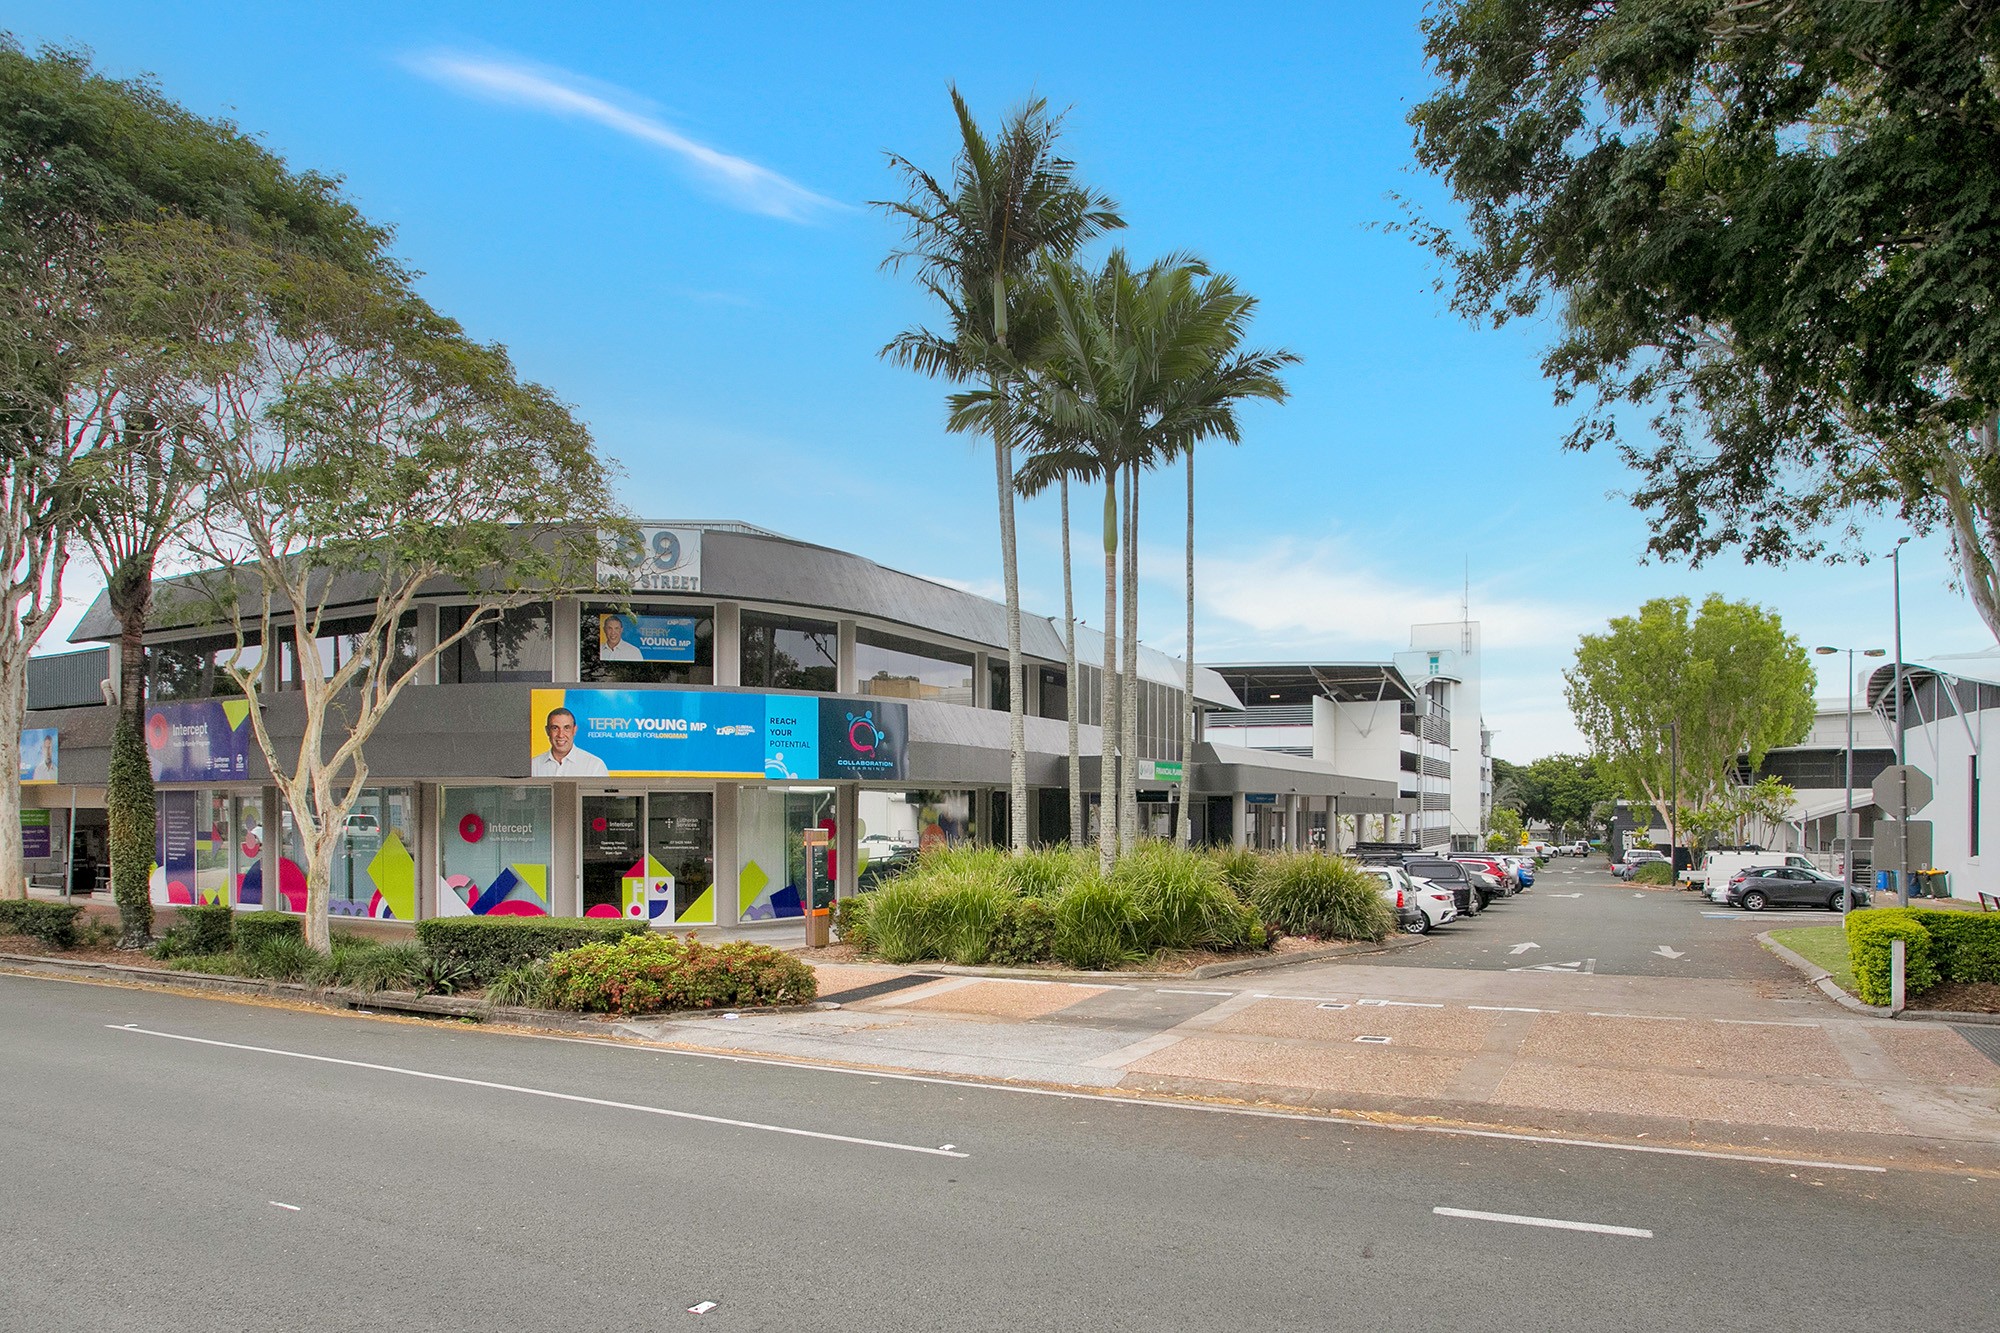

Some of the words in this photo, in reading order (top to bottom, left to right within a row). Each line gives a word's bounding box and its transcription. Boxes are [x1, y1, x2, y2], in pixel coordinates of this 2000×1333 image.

[598, 573, 636, 589] KG
[641, 574, 699, 591] STREET
[639, 627, 670, 637] TERRY
[640, 637, 677, 647] YOUNG
[588, 717, 632, 730] TERRY
[634, 718, 688, 731] YOUNG
[690, 722, 707, 731] MP
[770, 717, 797, 725] REACH
[172, 722, 208, 737] Intercept
[770, 729, 793, 737] YOUR
[588, 731, 614, 739] FEDERAL
[616, 731, 641, 739] MEMBER
[643, 731, 656, 739] FOR
[655, 732, 688, 740] LONGMAN
[770, 740, 811, 749] POTENTIAL
[837, 759, 894, 767] COLLABORATION
[489, 822, 533, 836] Intercept
